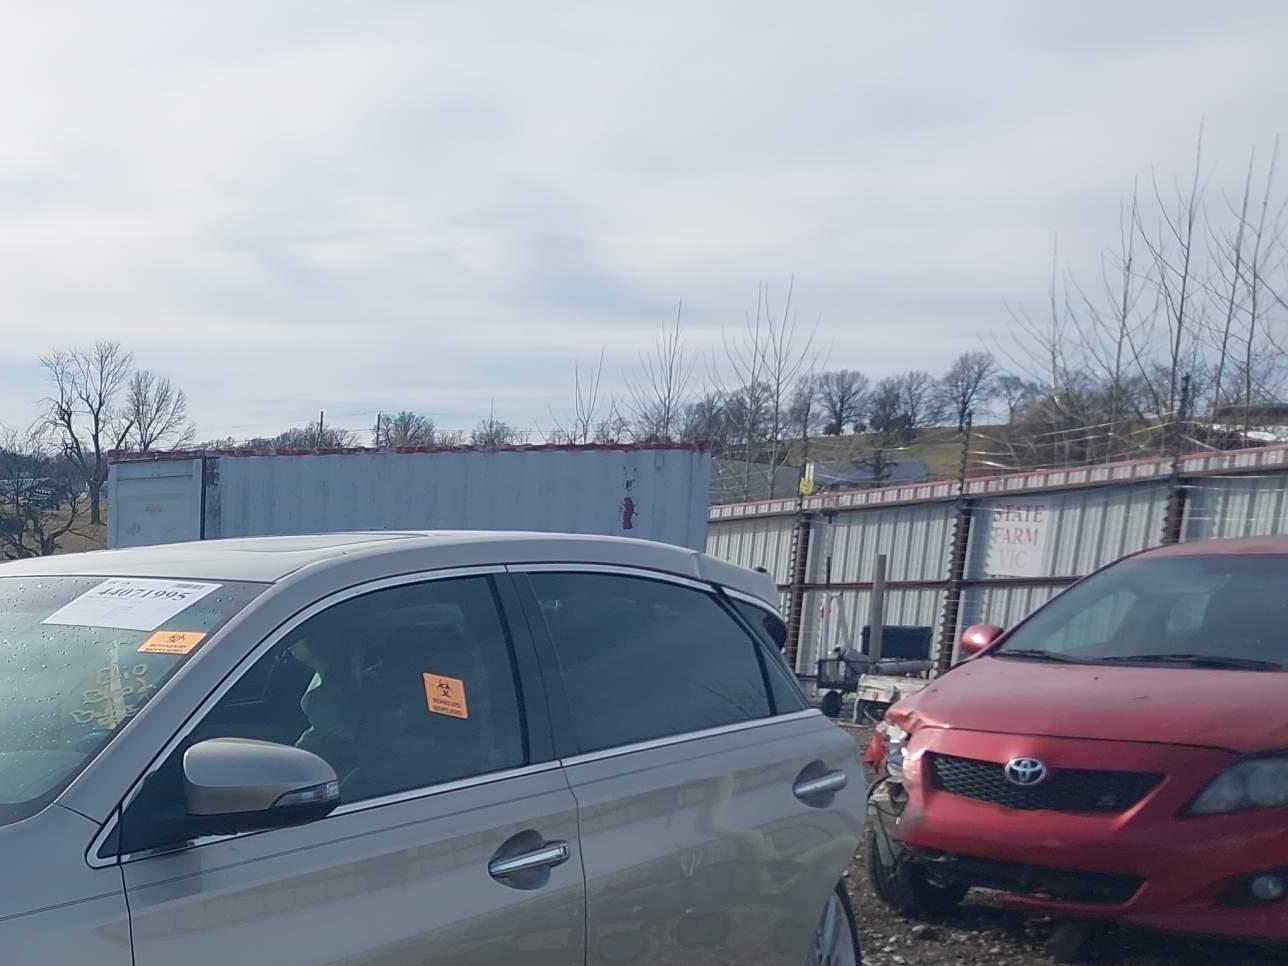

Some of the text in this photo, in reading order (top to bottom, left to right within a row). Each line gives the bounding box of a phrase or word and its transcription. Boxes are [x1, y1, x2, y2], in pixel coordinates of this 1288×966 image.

[993, 504, 1045, 522] STATE
[993, 528, 1039, 545] FARM
[97, 587, 192, 601] 44071995
